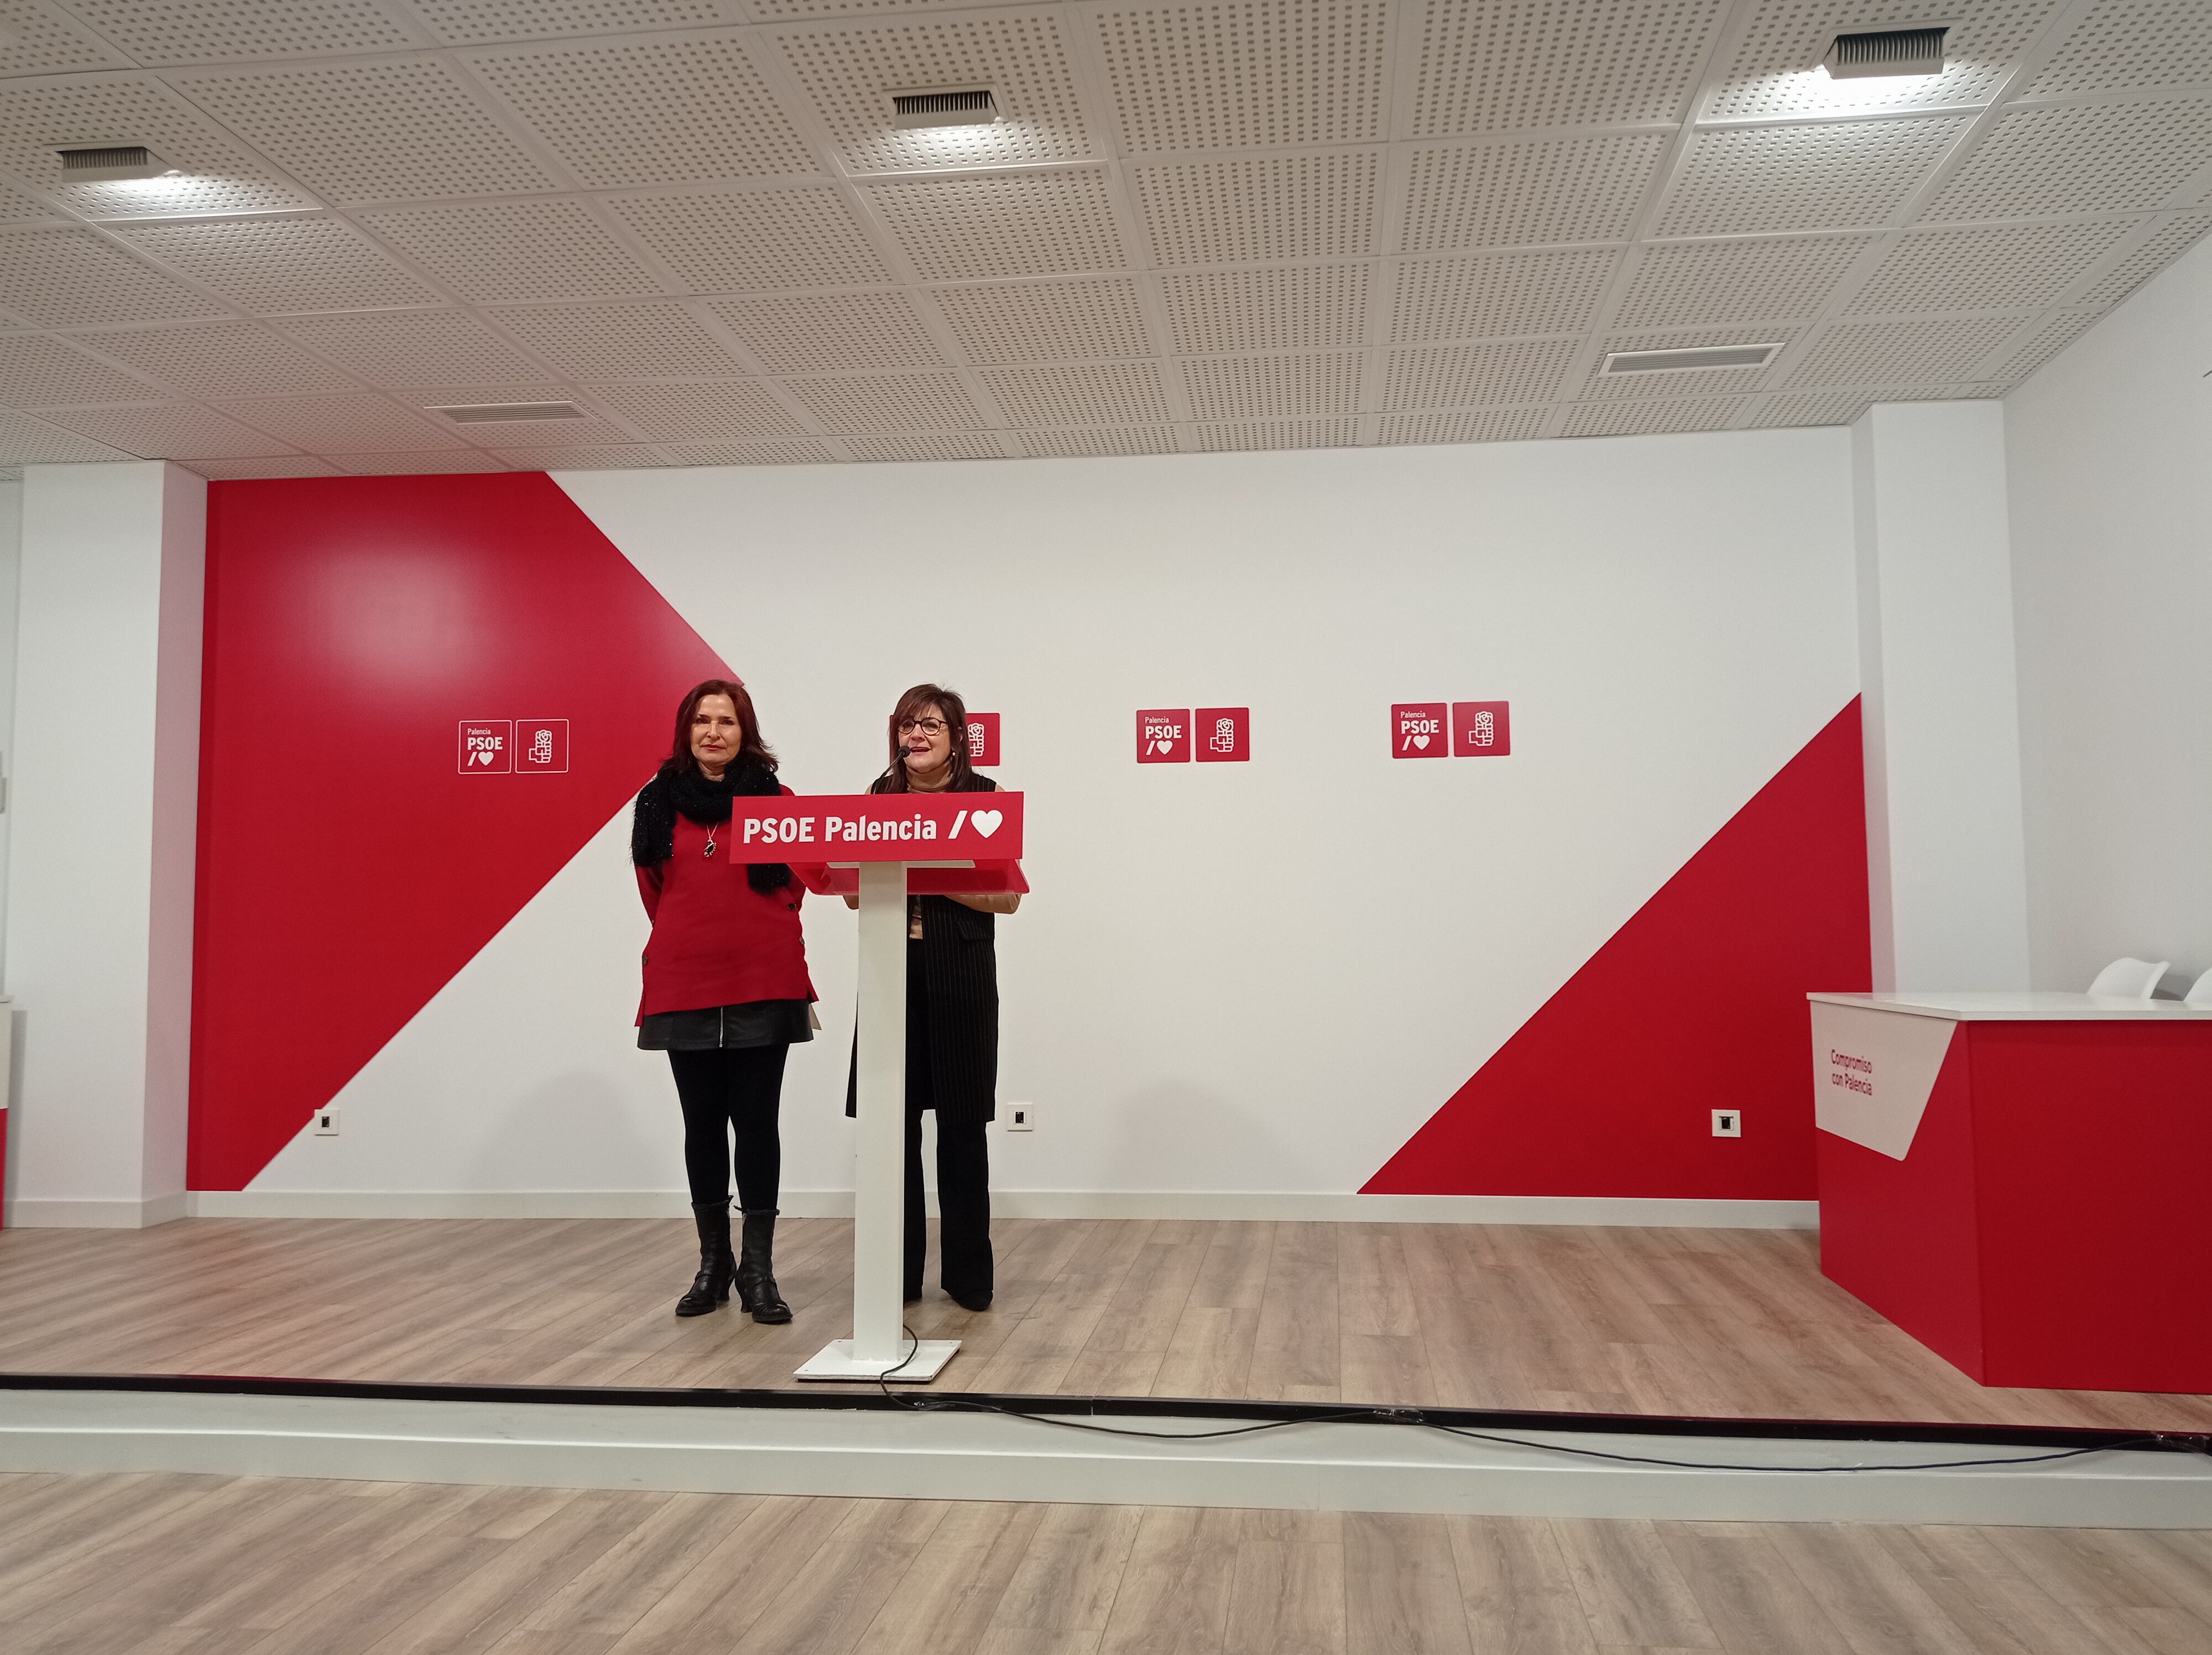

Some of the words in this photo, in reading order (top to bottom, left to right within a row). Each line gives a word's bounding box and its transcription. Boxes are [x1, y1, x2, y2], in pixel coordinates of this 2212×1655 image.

[1145, 725, 1182, 739] PSOE
[1401, 720, 1439, 734] PSOE
[467, 737, 503, 750] PSOE
[743, 818, 815, 844] PSOE
[825, 814, 937, 842] Palencia
[1832, 1049, 1872, 1074] Compromiso
[1832, 1073, 1844, 1087] con
[1844, 1073, 1872, 1096] Palencia
